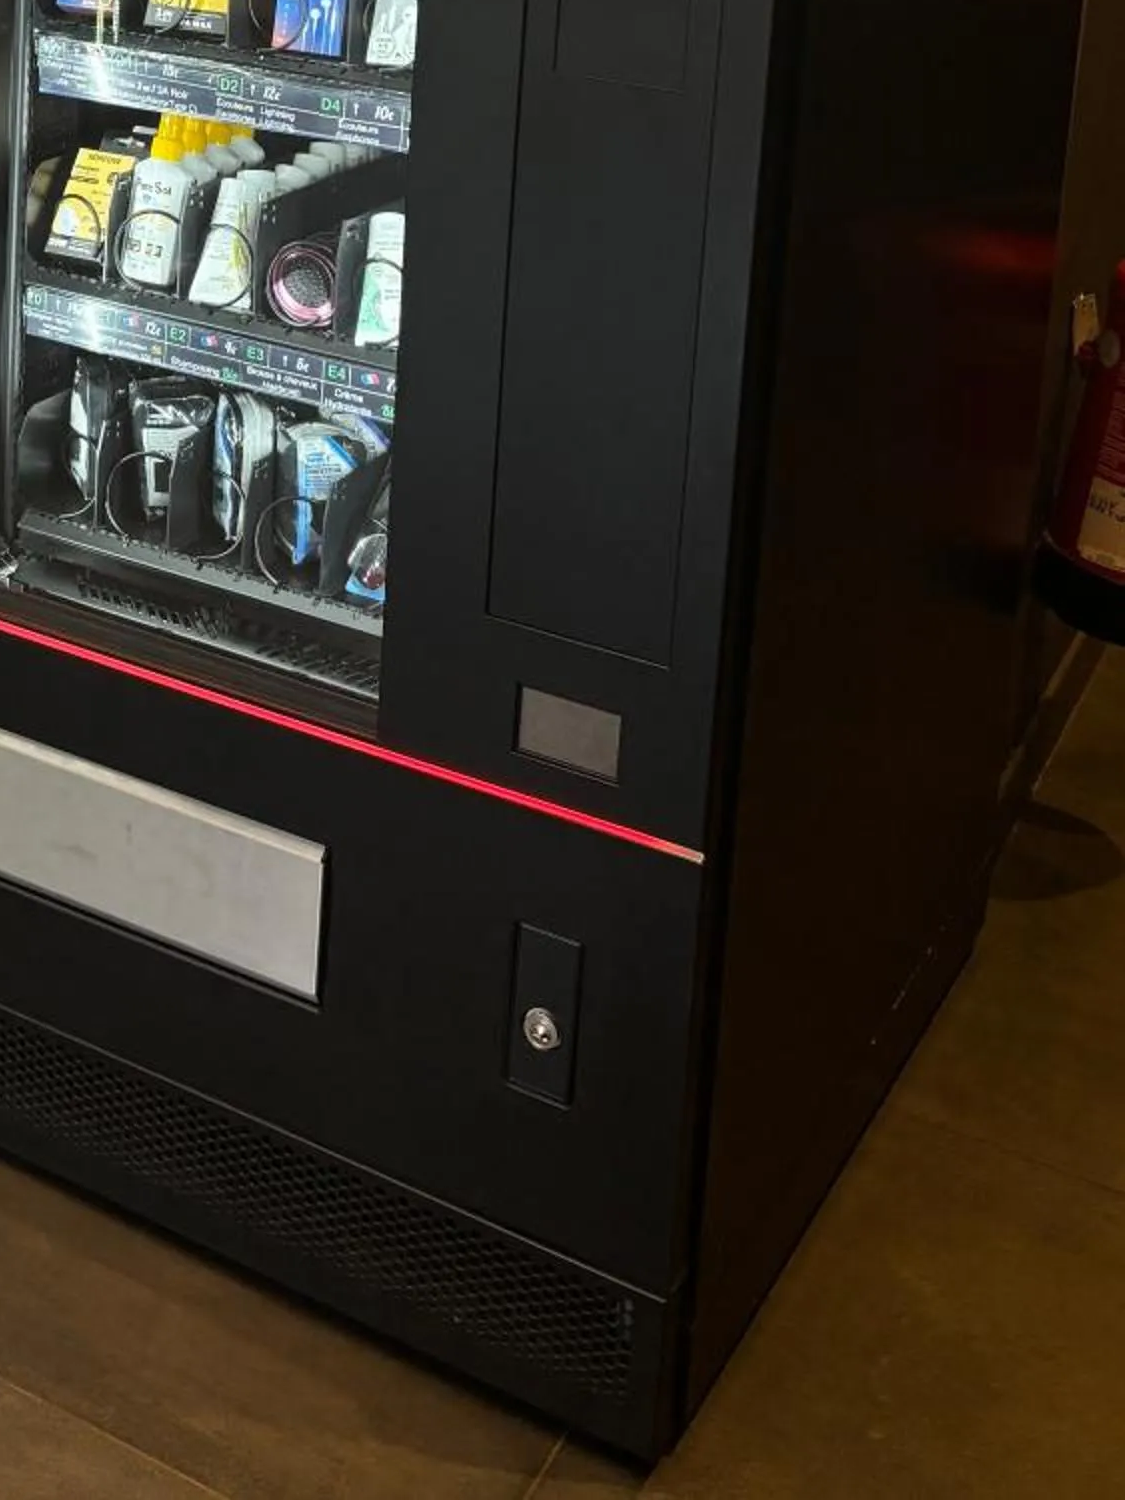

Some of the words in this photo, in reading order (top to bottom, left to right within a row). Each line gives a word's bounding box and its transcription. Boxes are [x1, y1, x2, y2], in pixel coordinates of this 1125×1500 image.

[219, 77, 240, 93] D2
[321, 97, 341, 113] D4
[169, 327, 186, 342] E2
[246, 345, 264, 361] E3
[327, 364, 346, 381] E4
